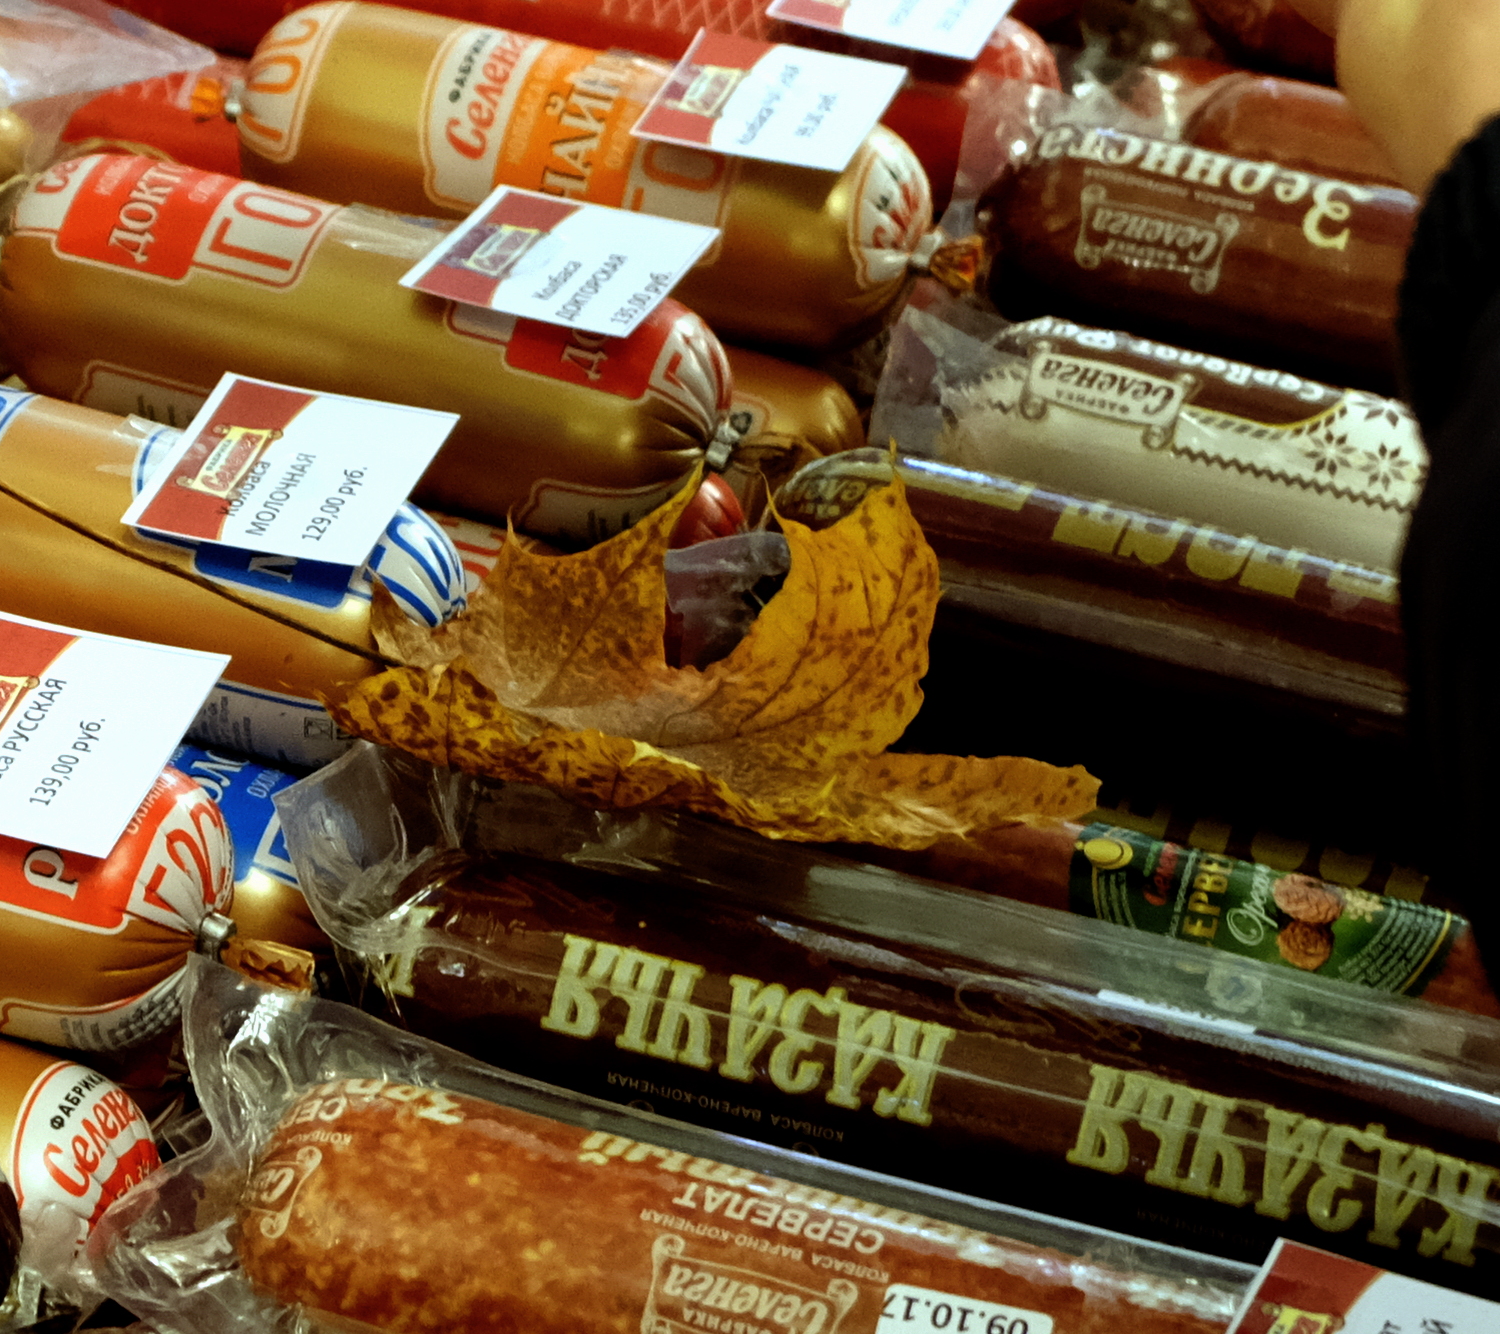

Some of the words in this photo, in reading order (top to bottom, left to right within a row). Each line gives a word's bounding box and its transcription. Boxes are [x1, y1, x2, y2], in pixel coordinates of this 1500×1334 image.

[1034, 121, 1377, 252] Зерниста
[1041, 358, 1177, 417] Селенга
[245, 452, 317, 537] МОЛОЧНАЯ
[302, 496, 347, 543] 129,00
[338, 466, 369, 497] руб.
[1, 677, 69, 754] РУССКАЯ
[29, 753, 81, 809] 139,00
[72, 716, 107, 754] руб.
[540, 932, 956, 1126] КАЗАЧЬЯ
[765, 1108, 846, 1145] КОЛБАСА
[674, 1181, 886, 1255] СЕРВЕЛАТ
[808, 1249, 891, 1285] КОЛБАСА
